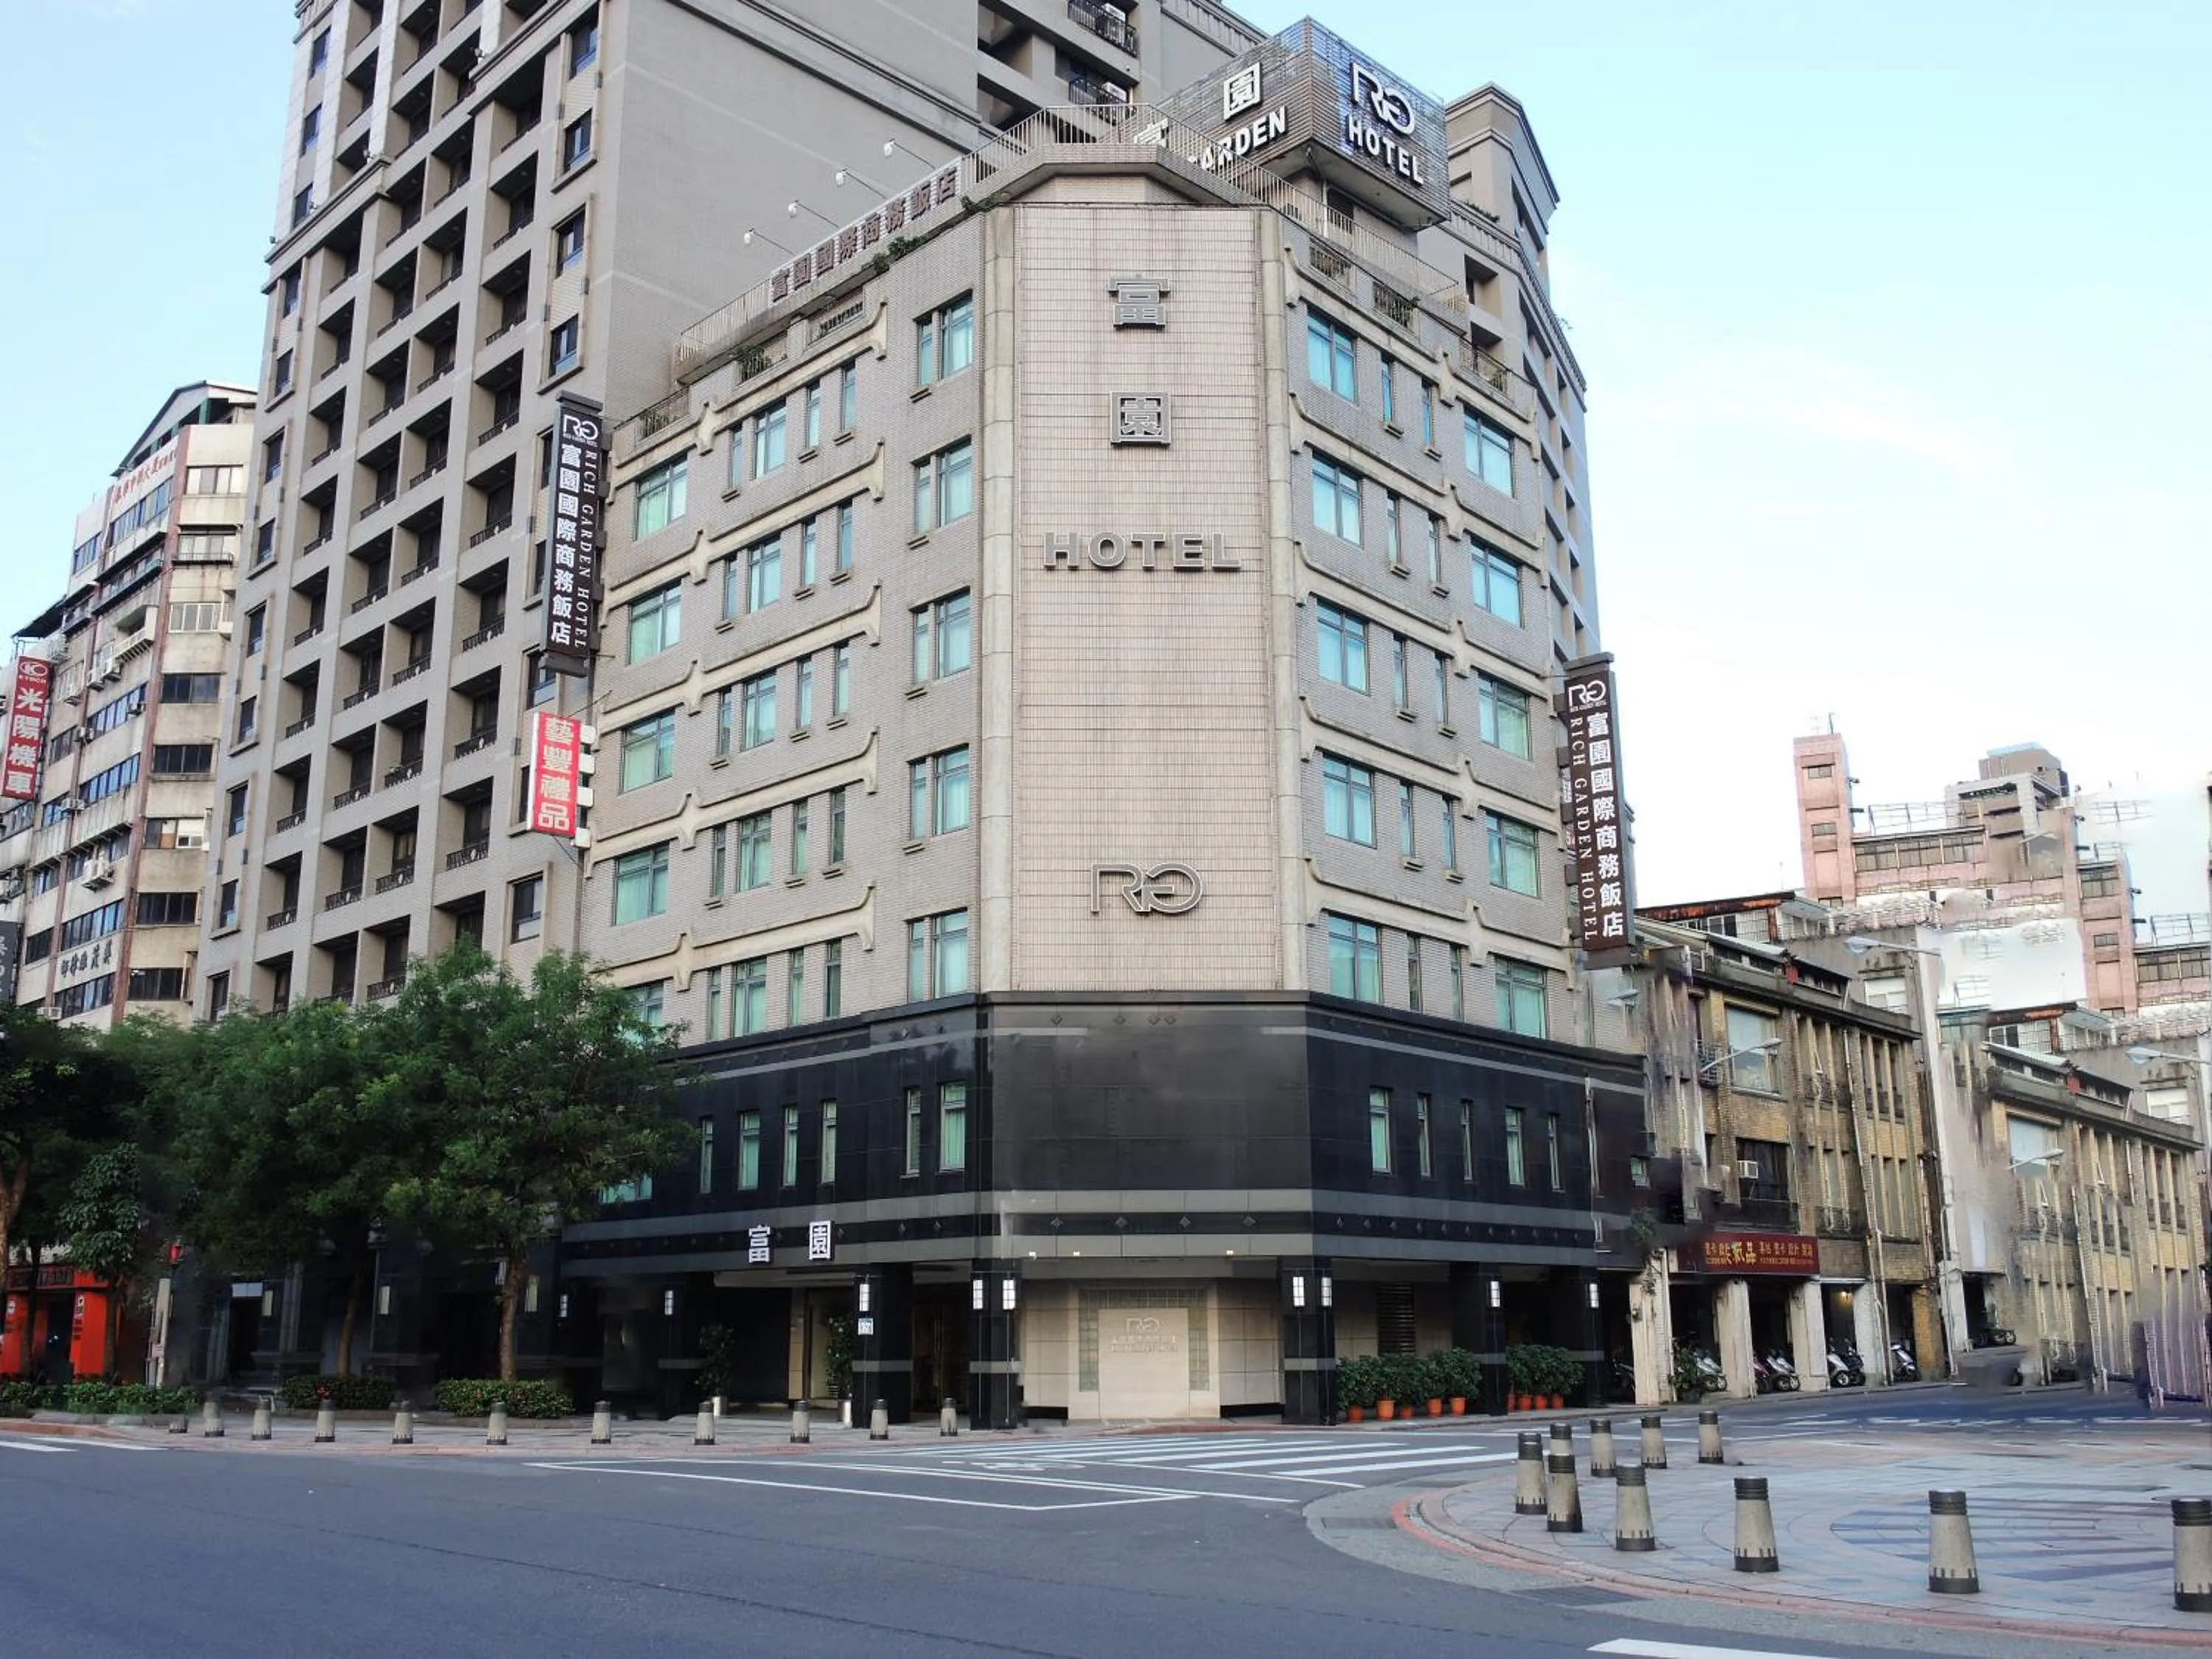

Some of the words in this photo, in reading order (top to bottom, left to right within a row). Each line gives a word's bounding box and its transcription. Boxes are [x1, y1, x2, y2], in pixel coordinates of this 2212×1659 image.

[1188, 105, 1287, 171] ARDEN
[1349, 114, 1424, 184] HOTEL
[583, 450, 597, 493] RICH
[552, 443, 581, 646] 富園國際商務飯店
[579, 505, 594, 577] GARDEN
[1043, 532, 1241, 570] HOTEL
[574, 590, 589, 648] HOTEL
[6, 687, 44, 794] 光陽機車
[1570, 717, 1586, 766] RICH
[1575, 779, 1593, 859] GARDEN
[1587, 712, 1623, 938] 富園國際商務飯店
[1581, 872, 1597, 939] HOTEL
